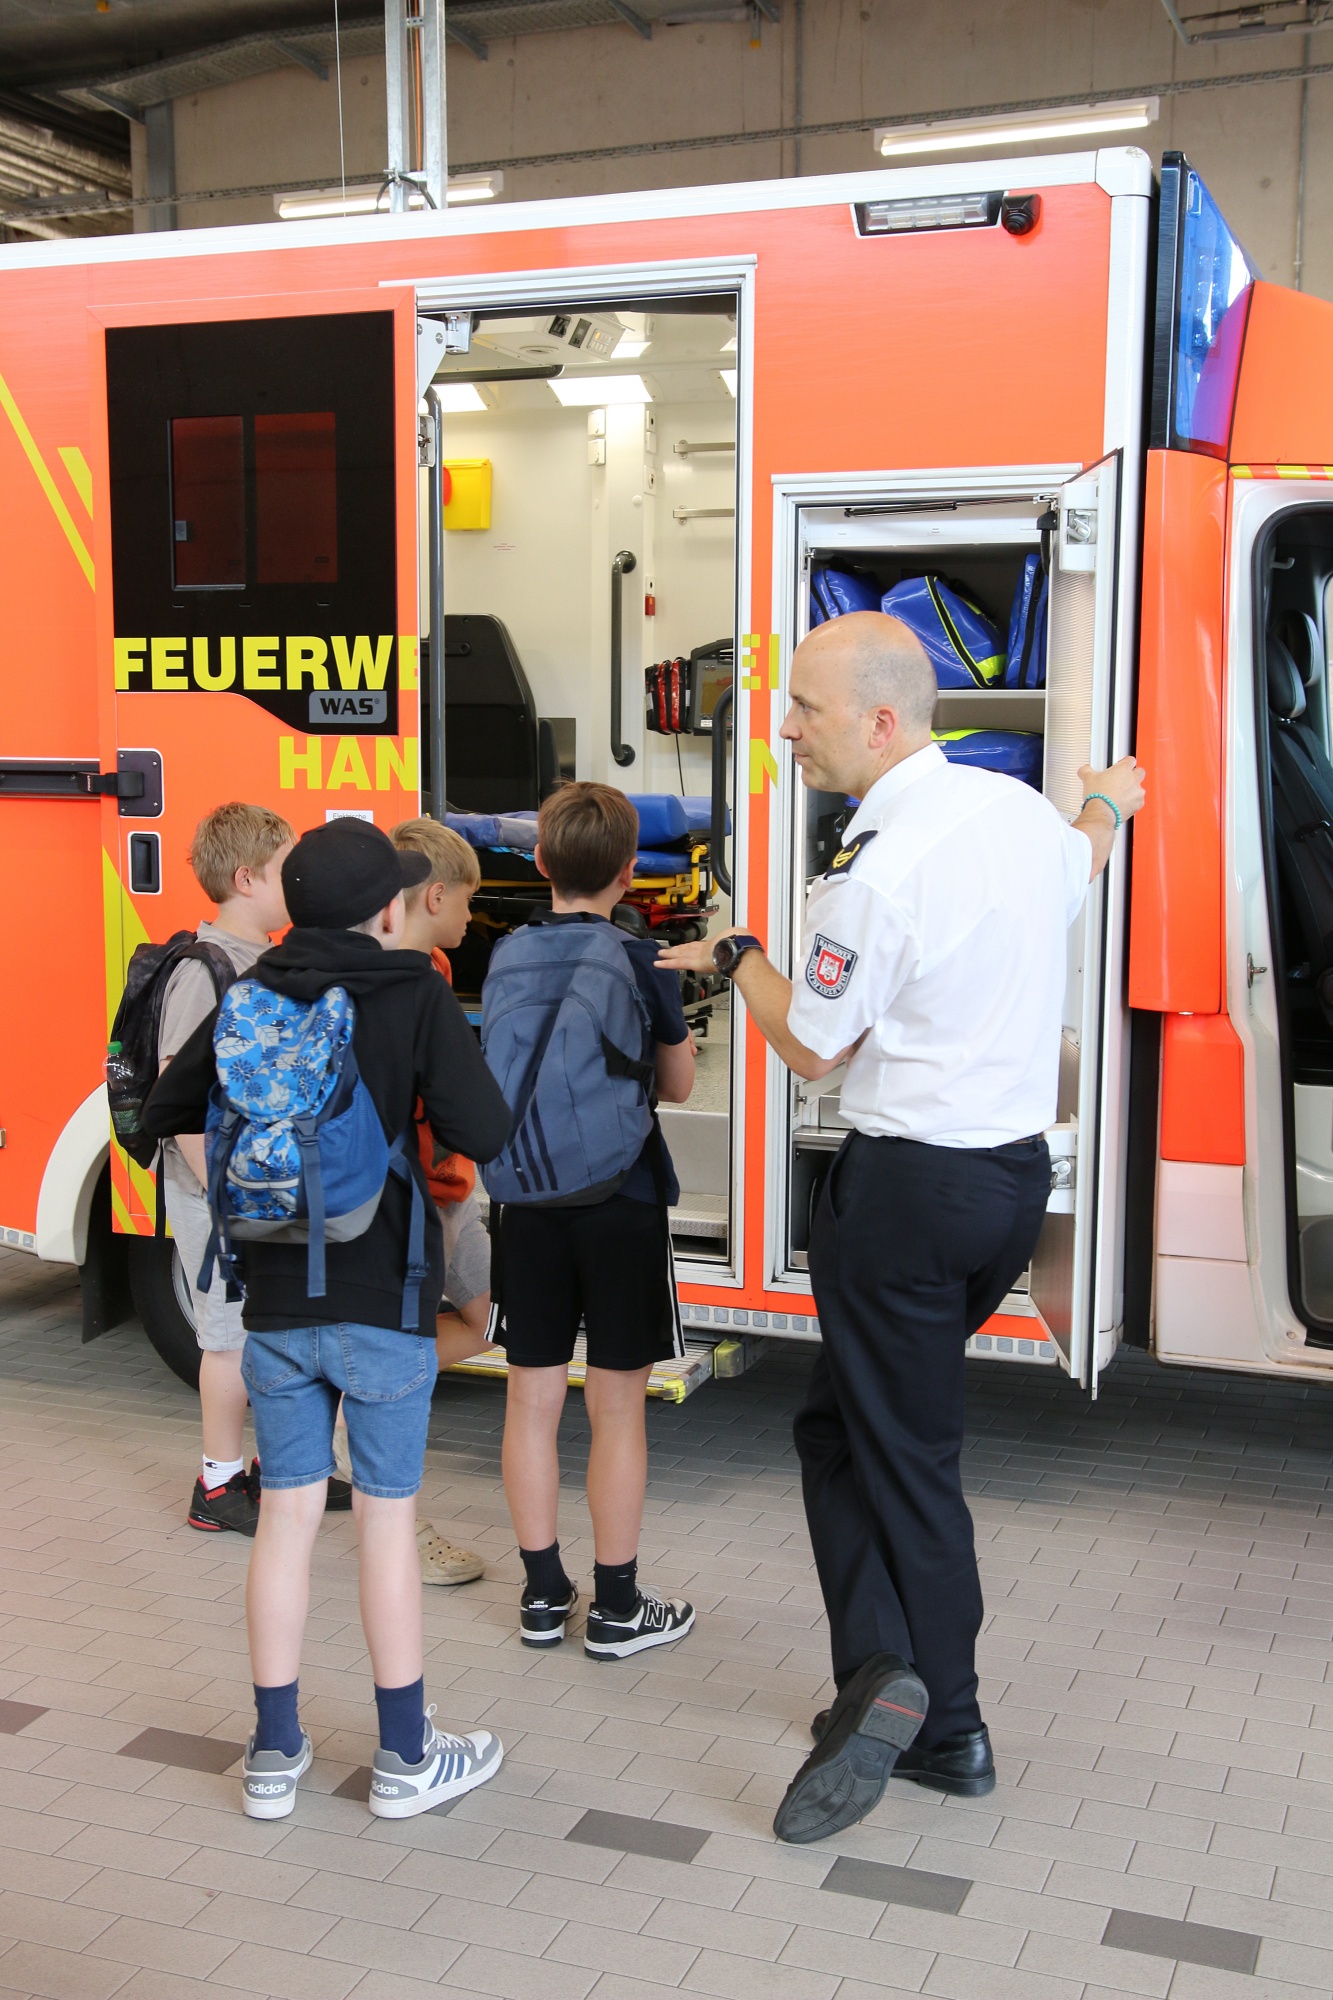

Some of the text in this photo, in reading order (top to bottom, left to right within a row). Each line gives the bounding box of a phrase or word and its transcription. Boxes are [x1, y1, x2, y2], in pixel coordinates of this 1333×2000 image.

[279, 735, 418, 791] HAN
[818, 939, 853, 961] HANNOVER
[248, 1782, 287, 1795] adidas
